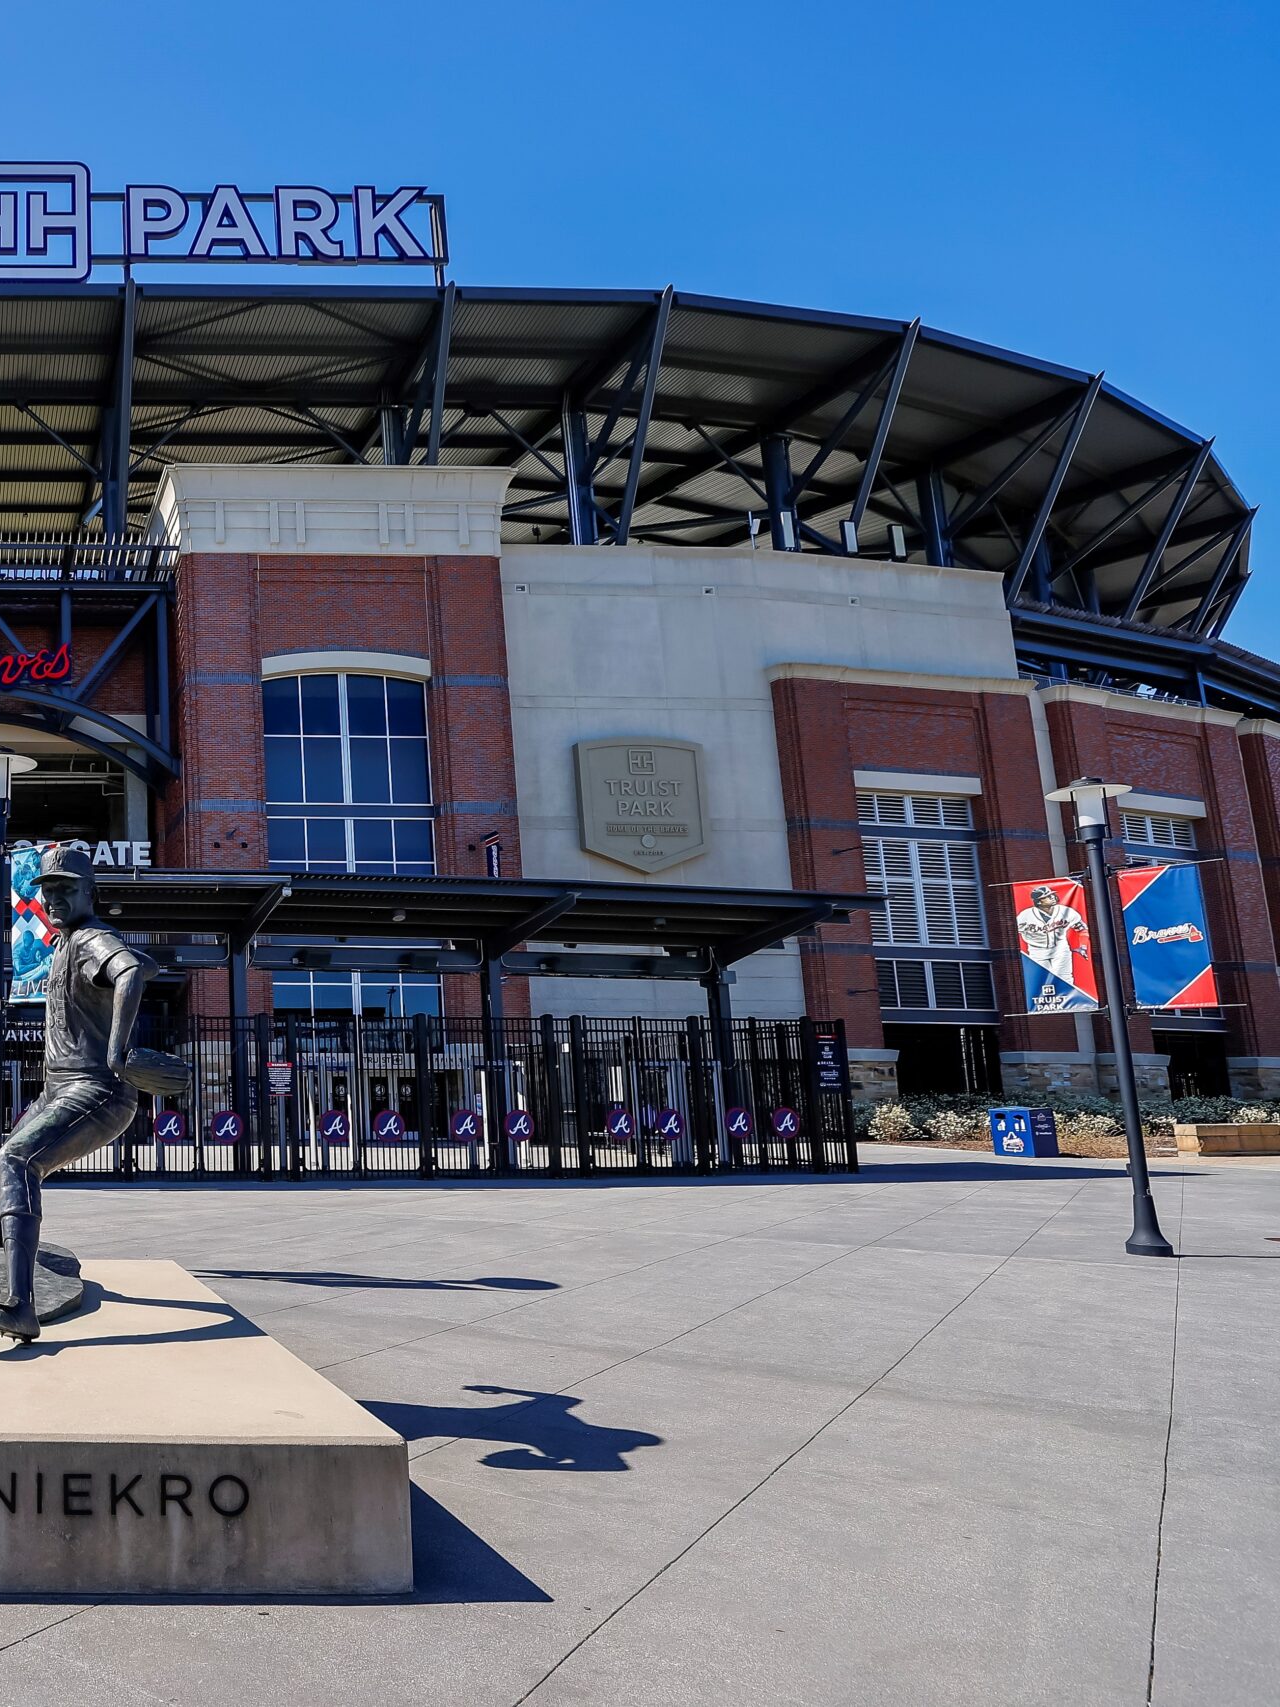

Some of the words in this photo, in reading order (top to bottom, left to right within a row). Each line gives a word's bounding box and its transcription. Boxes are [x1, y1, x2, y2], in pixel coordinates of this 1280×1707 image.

[123, 183, 429, 264] PARK
[604, 779, 683, 797] TRUIST
[617, 799, 675, 817] PARK
[1131, 922, 1193, 946] Braves
[16, 979, 50, 997] LIVE
[1031, 995, 1068, 1005] TRUIST
[1036, 1003, 1064, 1012] PARK
[361, 1055, 392, 1065] TRUST
[158, 1115, 180, 1136] A
[215, 1115, 238, 1137] A
[323, 1115, 345, 1136] A
[378, 1115, 400, 1136] A
[455, 1114, 476, 1135] A
[509, 1114, 530, 1135] A
[610, 1113, 630, 1134] A
[661, 1113, 680, 1134] A
[729, 1112, 748, 1132] A
[776, 1112, 796, 1132] A
